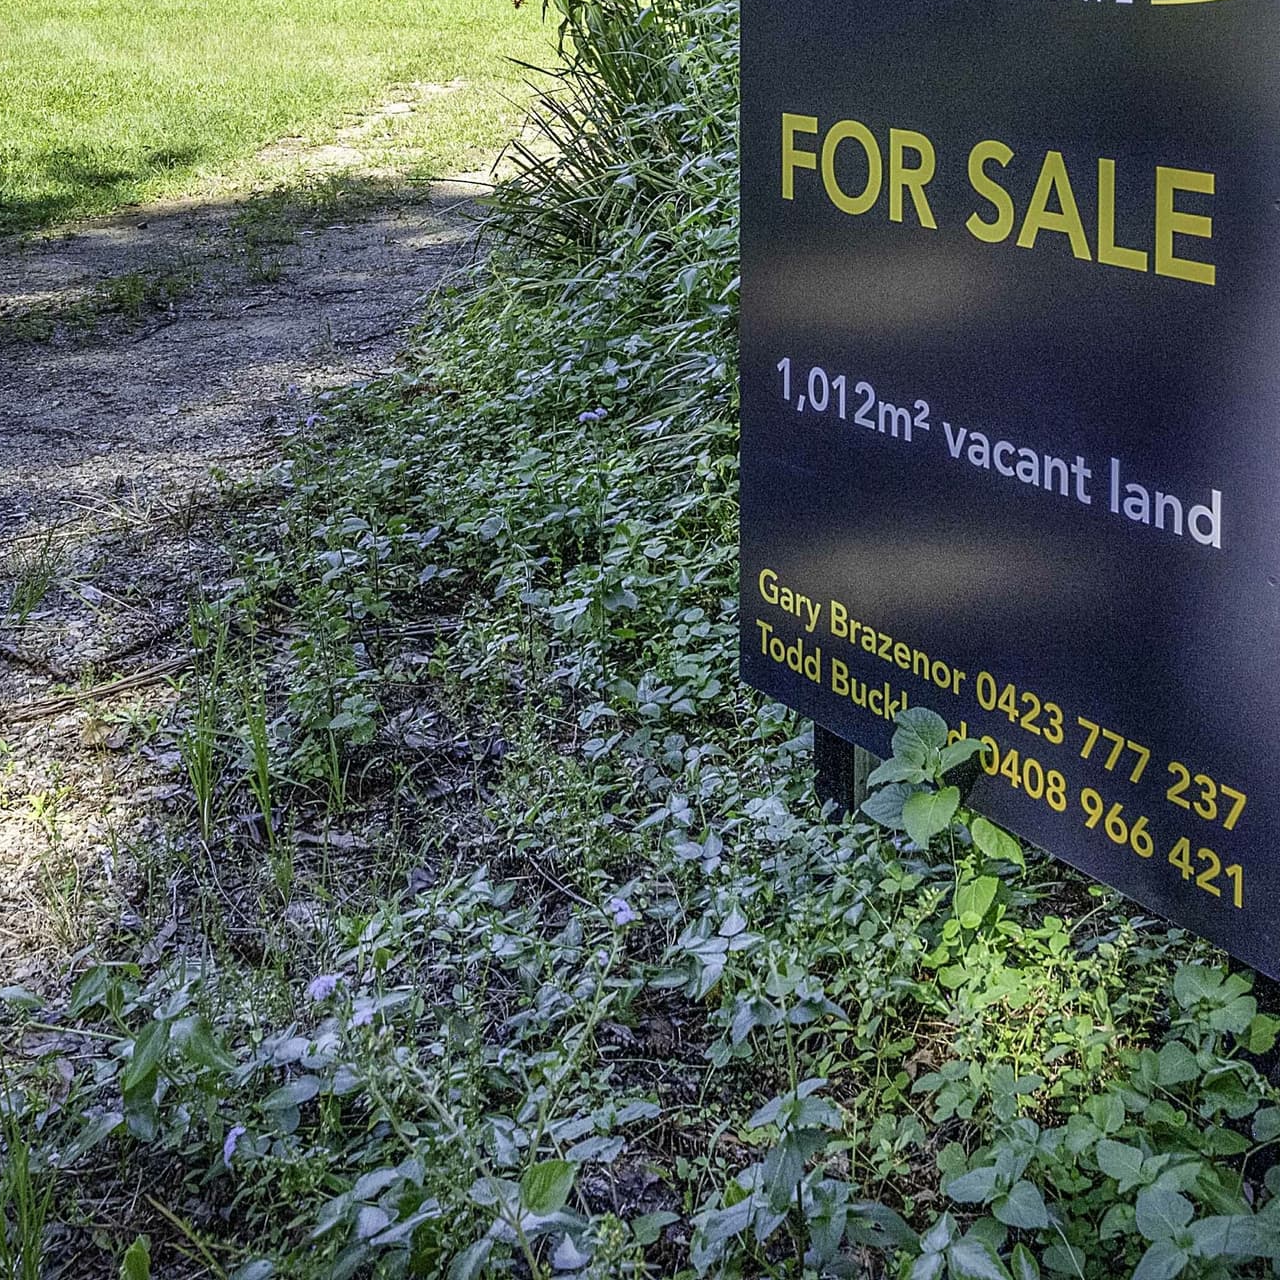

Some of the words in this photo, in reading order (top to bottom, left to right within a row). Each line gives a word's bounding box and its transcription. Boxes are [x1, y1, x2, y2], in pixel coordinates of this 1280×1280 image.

[782, 113, 937, 229] FOR
[965, 140, 1216, 286] SALE
[776, 357, 930, 442] 1,012m²
[943, 422, 1092, 504] vacant
[1111, 458, 1222, 548] land
[756, 619, 821, 683] Todd
[979, 736, 1067, 812] 0408
[1080, 788, 1154, 858] 966
[1168, 837, 1243, 908] 421
[759, 569, 821, 632] Gary
[830, 600, 966, 695] Brazenor
[976, 672, 1064, 744] 0423
[1078, 717, 1151, 783] 777
[1166, 762, 1247, 831] 237
